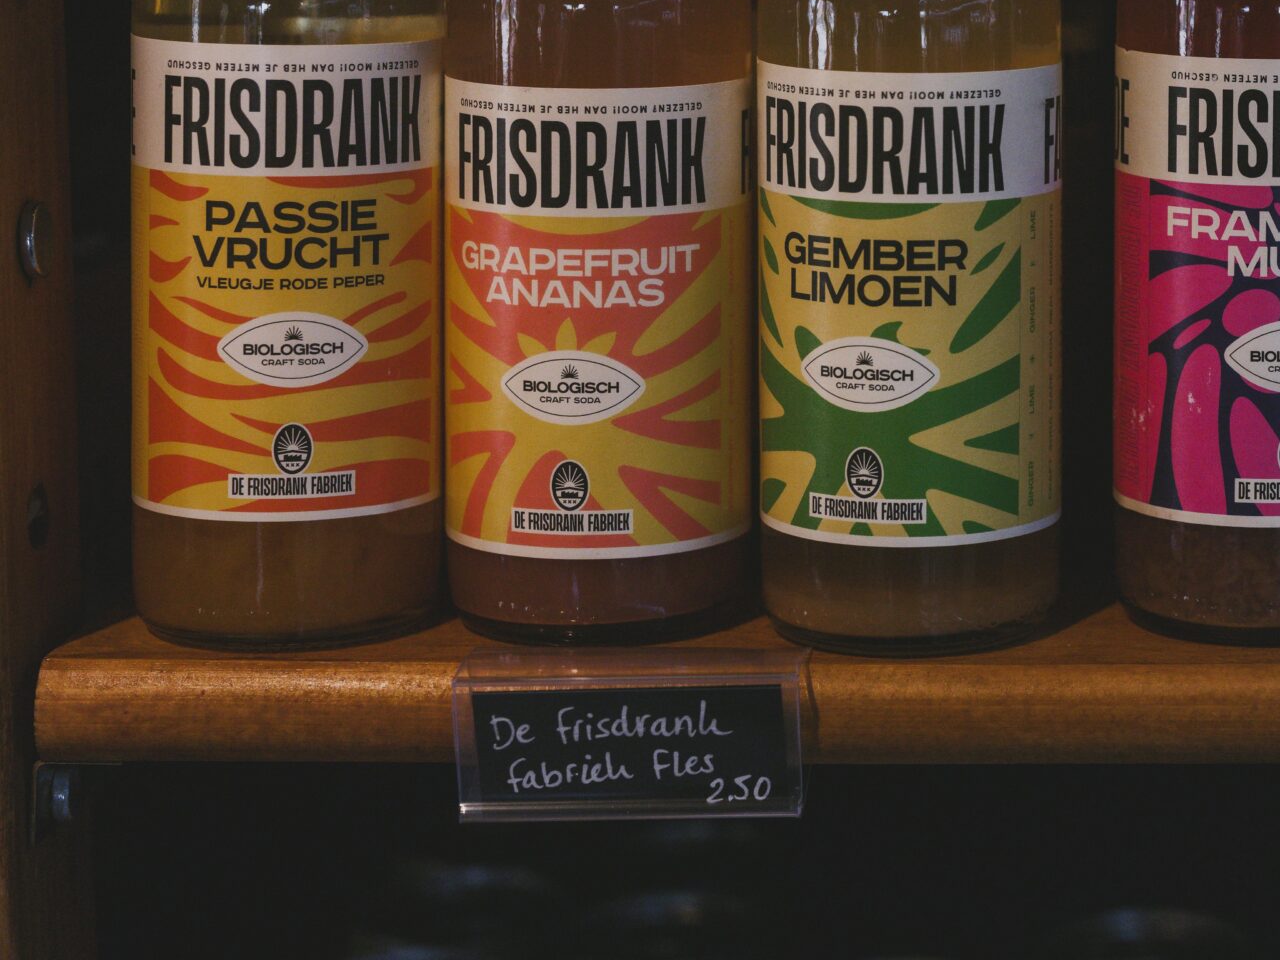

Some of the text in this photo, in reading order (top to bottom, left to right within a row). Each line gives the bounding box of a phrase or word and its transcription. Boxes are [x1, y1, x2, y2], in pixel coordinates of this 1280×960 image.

[167, 60, 210, 70] GESCHUD
[216, 62, 259, 72] METEEN
[265, 63, 278, 72] JE
[284, 63, 306, 73] HEB
[311, 63, 334, 73] DAN
[461, 98, 493, 109] GESCHUD
[497, 102, 535, 113] METEEN
[540, 105, 552, 113] JE
[557, 105, 578, 114] HEB
[584, 106, 607, 114] DAN
[164, 74, 421, 168] FRISDRANK
[766, 95, 1005, 195] FRISDRANK
[459, 113, 706, 208] FRISDRANK
[205, 199, 377, 234] PASSIE
[193, 234, 389, 270] VRUCHT
[462, 240, 700, 277] GRAPEFRUIT
[784, 231, 968, 271] GEMBER
[197, 274, 385, 290] VLEUGJE RODE PEPER
[790, 267, 957, 308] LIMOEN
[486, 276, 664, 309] ANANAS
[243, 342, 344, 356] BIOLOGISCH
[261, 358, 325, 367] CRAFT SODA
[820, 365, 914, 382] BIOLOGISCH
[523, 380, 619, 394] BIOLOGISCH
[835, 382, 895, 391] CRAFT SODA
[539, 396, 601, 404] CRAFT SODA
[232, 474, 352, 496] DE FRISDRANK FABRIEK
[1238, 480, 1251, 500] DE
[812, 495, 923, 521] DE FRISDRANK FABRIEK
[514, 510, 630, 532] DE FRISDRANK FABRIEK
[490, 715, 536, 751] De
[705, 775, 772, 804] 2.50
